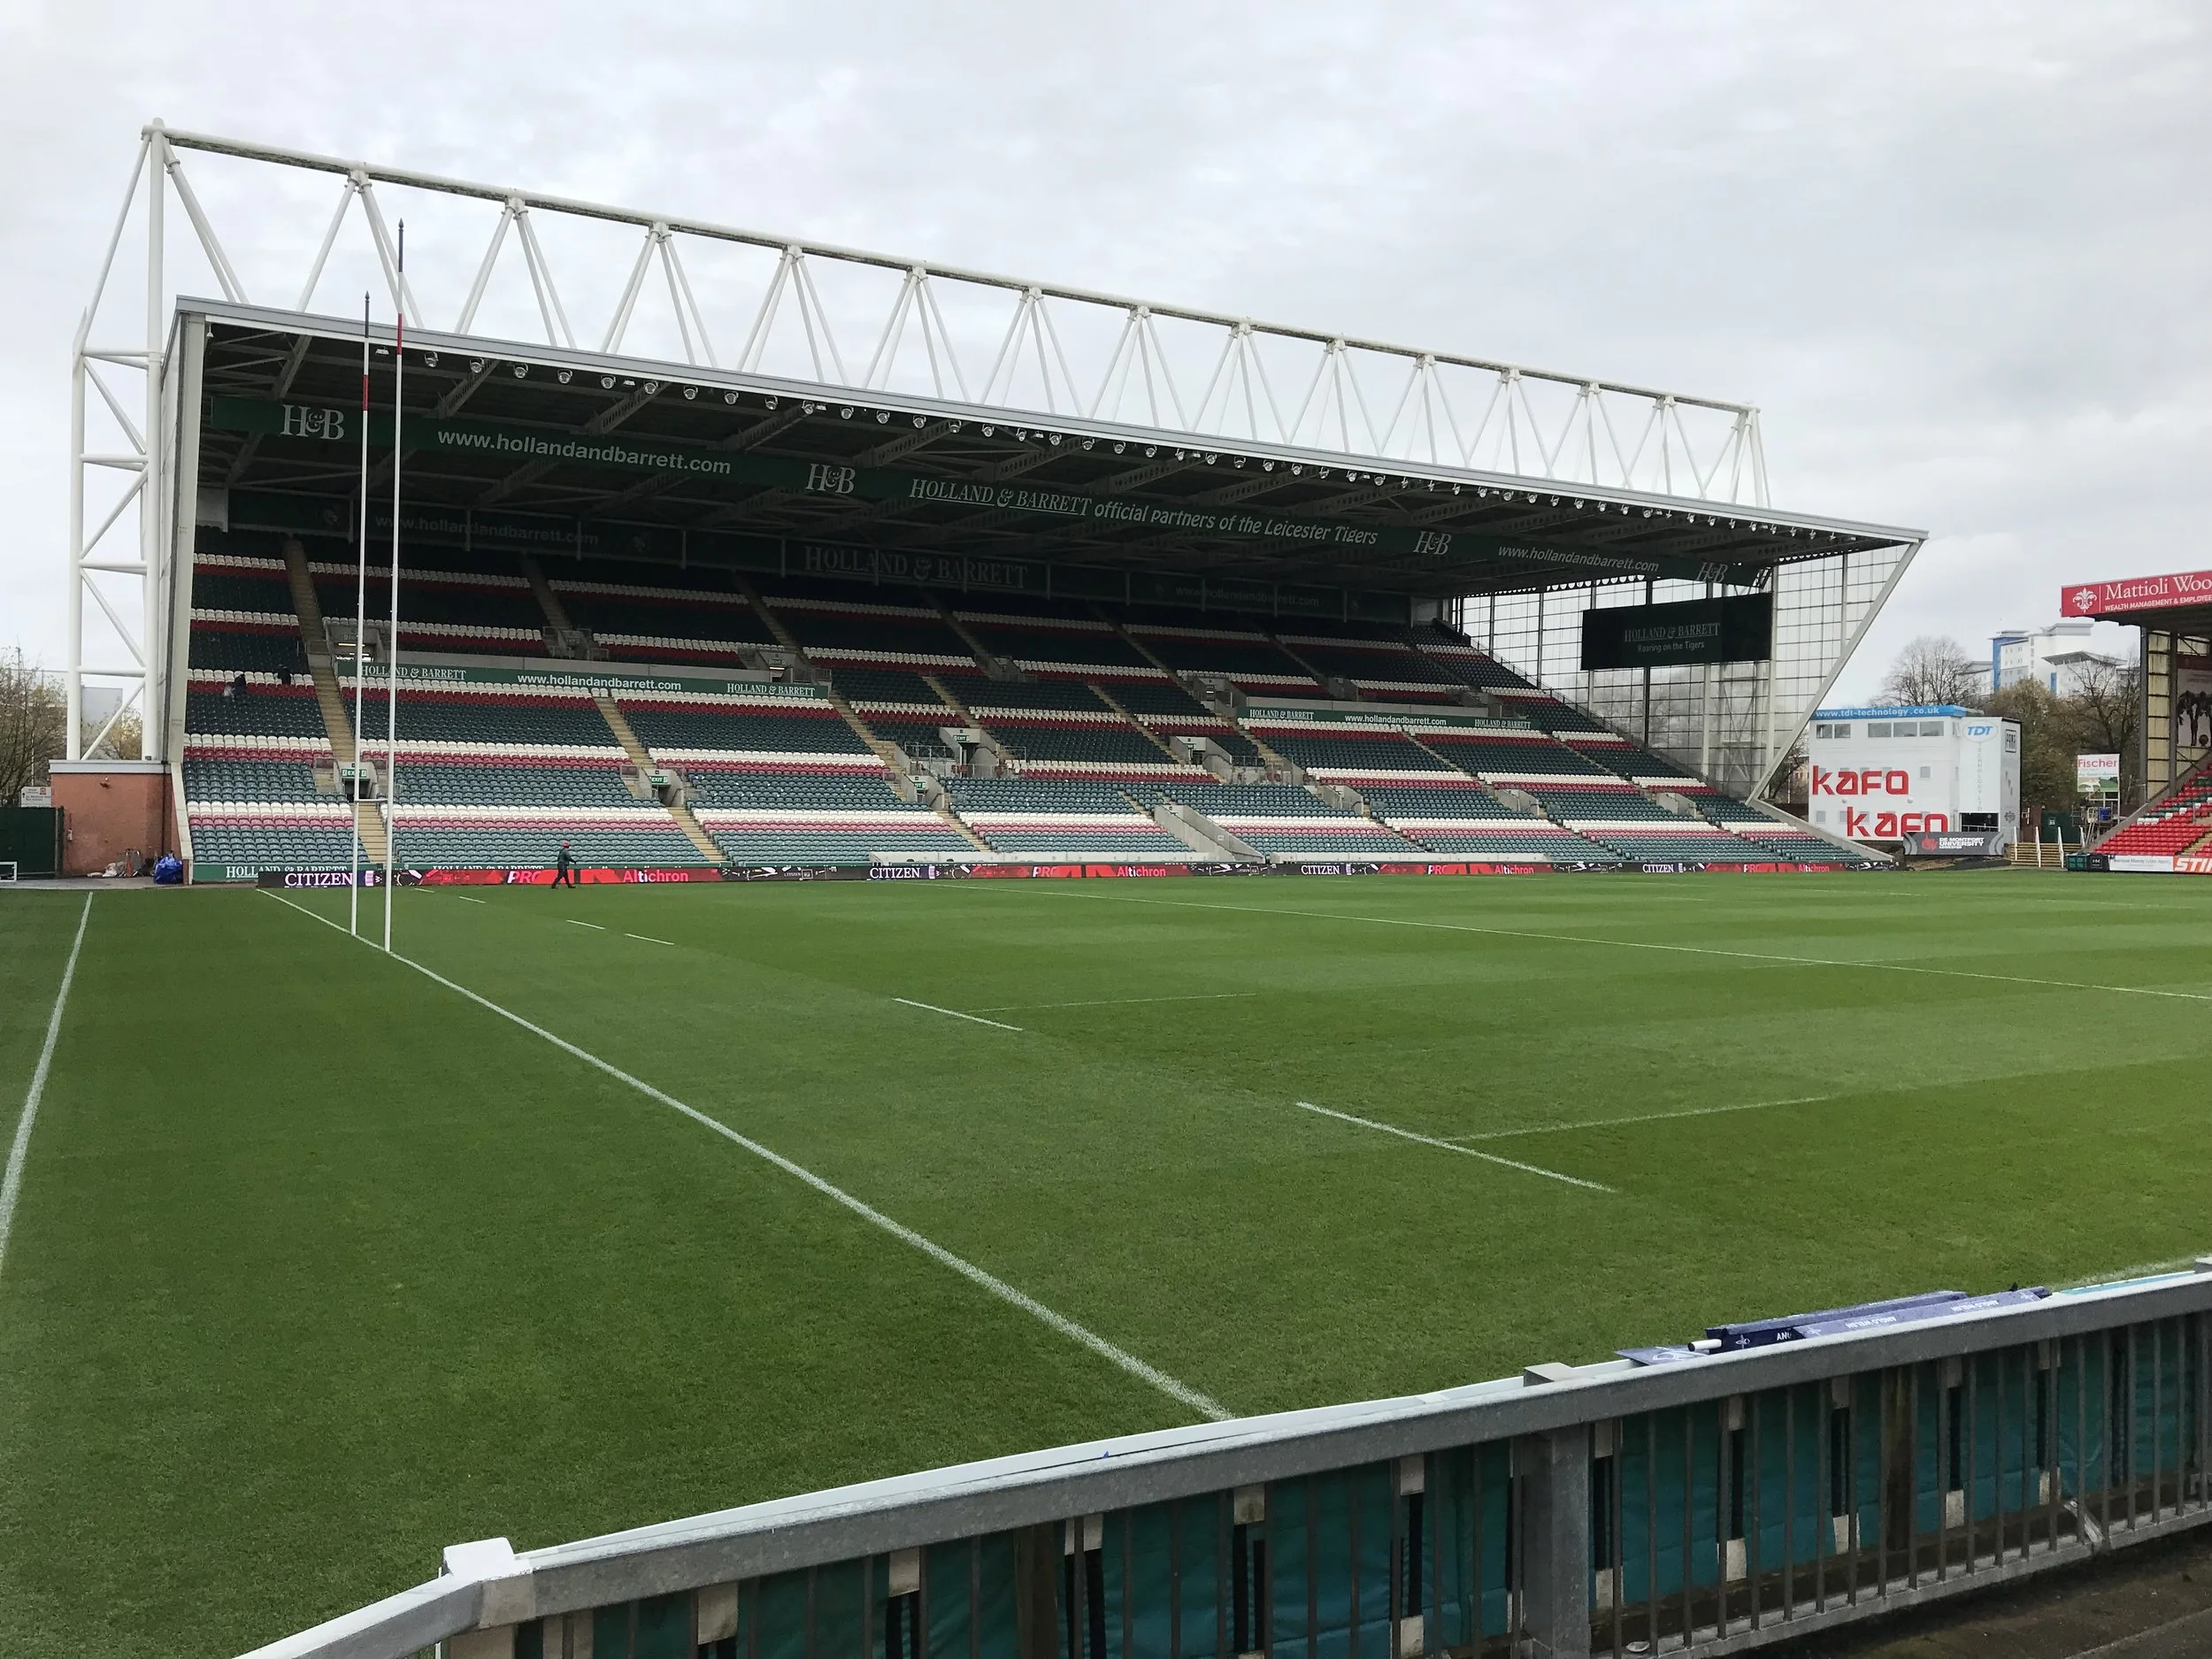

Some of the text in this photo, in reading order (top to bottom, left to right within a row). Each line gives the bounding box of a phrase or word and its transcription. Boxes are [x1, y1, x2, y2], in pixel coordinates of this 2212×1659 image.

[281, 403, 345, 442] H&B
[438, 430, 731, 475] www.hollandandbarrett.com
[805, 463, 856, 495] H&B
[909, 479, 1378, 545] HOLLAND & BARRETT official partners of the Leicester Tigers
[1413, 531, 1452, 555] H&B
[1498, 544, 1659, 572] www.hollandandbarrett.com
[804, 546, 908, 576] HOLLAND
[936, 558, 1029, 588] BARRETT
[2105, 578, 2170, 601] Mattioli
[2130, 598, 2173, 609] MANAGEMENT
[1624, 627, 1666, 642] HOLLAND
[1678, 622, 1720, 638] BARRETT
[410, 667, 419, 679] &
[422, 668, 466, 680] BARRETT
[517, 674, 682, 690] www.hollandandbarrett.com
[727, 683, 767, 694] HOLLAND
[779, 687, 816, 697] BARRETT
[1249, 710, 1279, 718] HOLLAND
[1286, 710, 1314, 720] BARRETT
[1344, 715, 1447, 726] www.hollandandbarrett.com
[1967, 726, 1993, 736] TDT
[870, 867, 920, 879] CITIZEN
[1117, 866, 1165, 877] Altichron
[1301, 865, 1340, 875] CITIZEN
[1494, 865, 1534, 874] Altichron
[1642, 864, 1673, 872] CITIZEN
[285, 872, 352, 887] CITIZEN
[621, 869, 687, 882] Altichron
